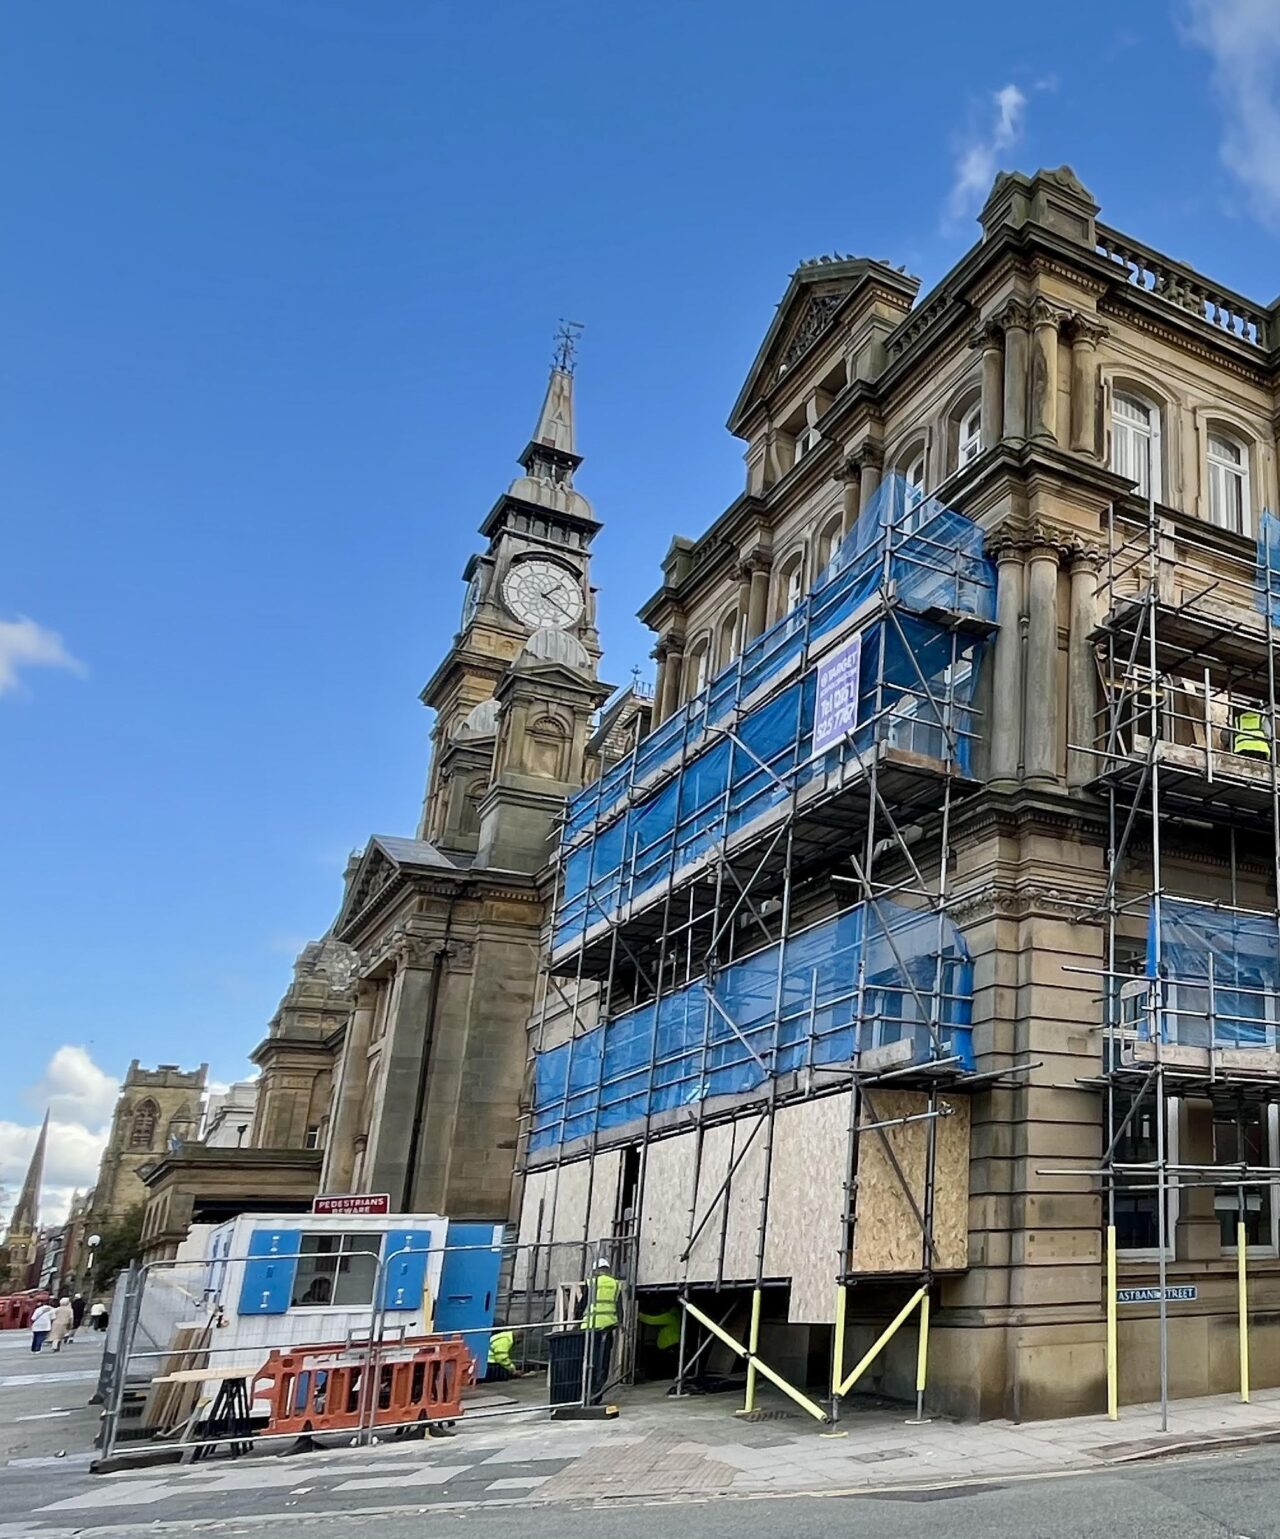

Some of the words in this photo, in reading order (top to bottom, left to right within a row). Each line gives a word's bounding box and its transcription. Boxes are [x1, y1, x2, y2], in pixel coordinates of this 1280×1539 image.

[318, 1198, 384, 1209] PEDESTRIANS
[1118, 1290, 1161, 1300] ASTBAN
[1163, 1288, 1193, 1299] TREET
